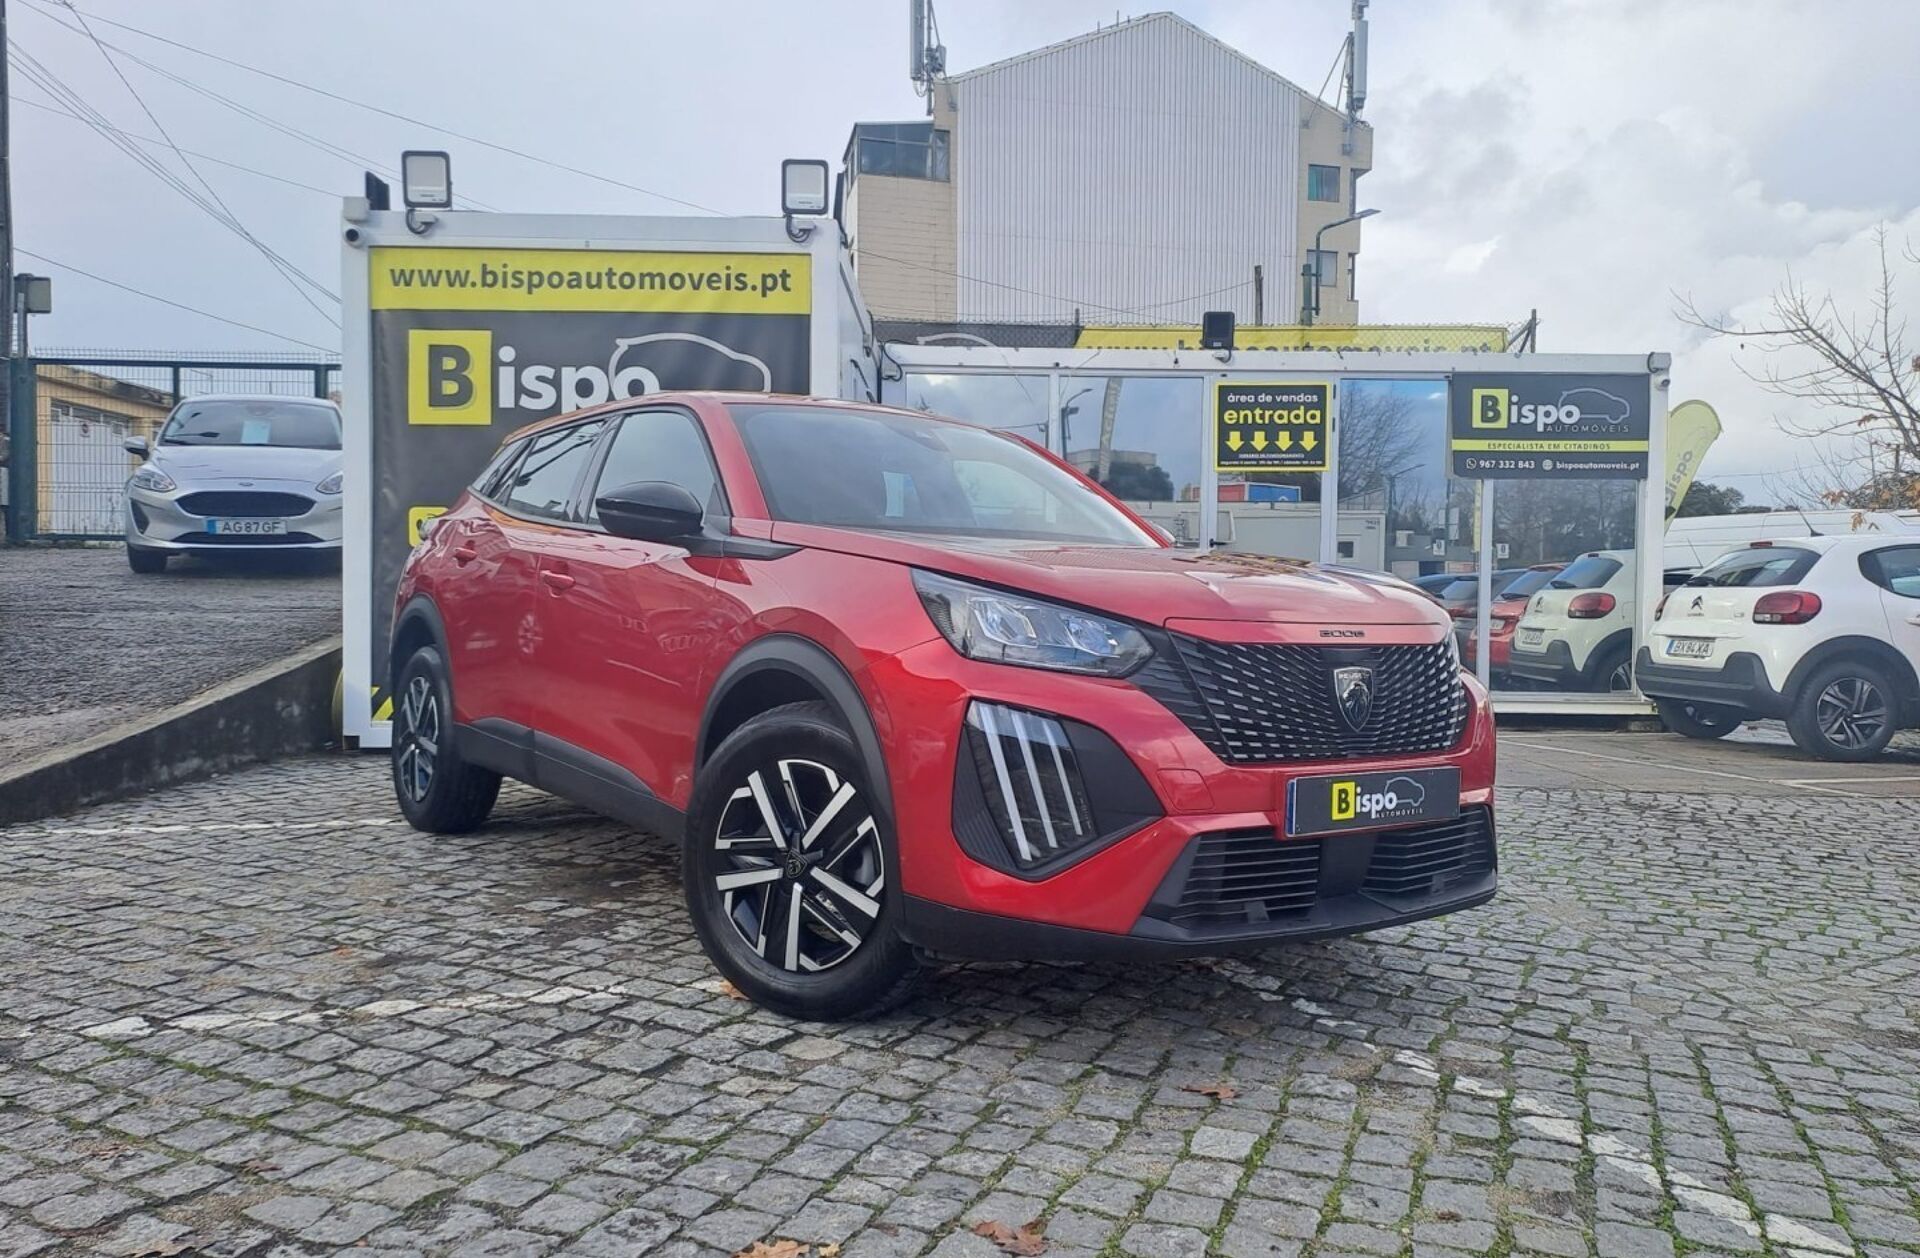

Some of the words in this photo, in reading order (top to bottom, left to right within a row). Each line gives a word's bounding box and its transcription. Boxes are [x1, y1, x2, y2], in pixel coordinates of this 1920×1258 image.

[389, 263, 792, 298] www.bispoautomoveis.pt
[427, 344, 661, 416] Bispo
[1258, 393, 1273, 403] de
[1275, 393, 1319, 403] vendas
[1223, 405, 1321, 425] entrada
[1480, 394, 1581, 432] Bispo
[1487, 442, 1545, 450] ESPECIALISTA
[1563, 443, 1611, 451] CITADINOS
[1479, 460, 1496, 469] 967
[1498, 460, 1516, 470] 332
[1518, 460, 1536, 470] 843
[1556, 461, 1640, 471] bispoautomoveis.pt
[1337, 786, 1397, 819] Bispo
